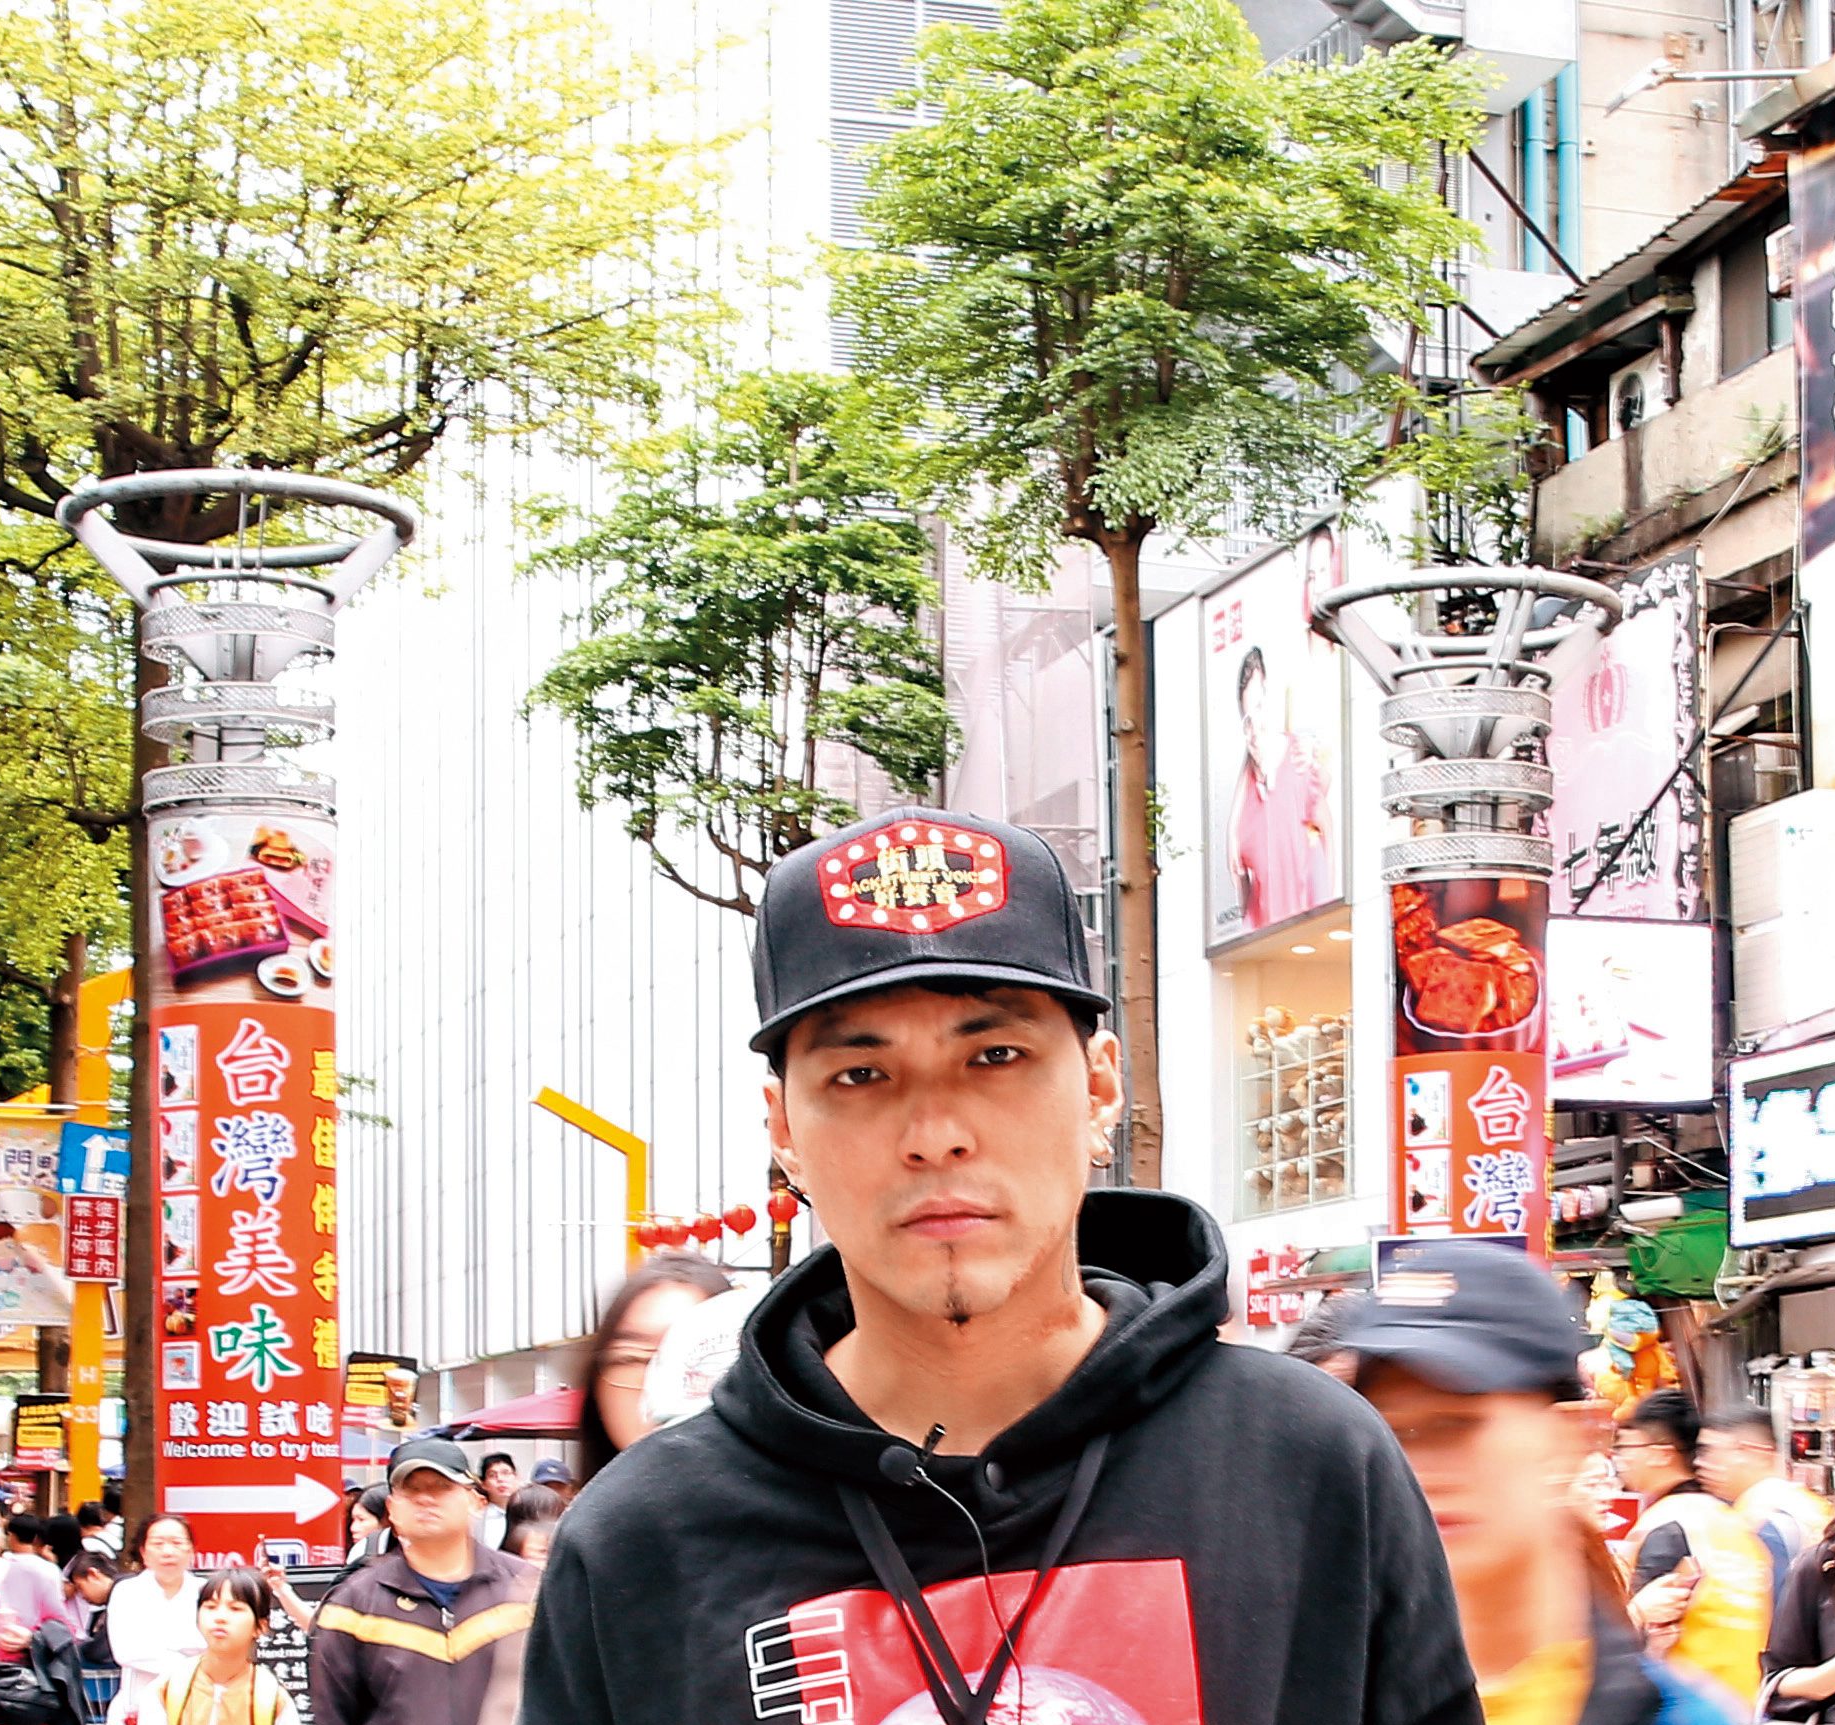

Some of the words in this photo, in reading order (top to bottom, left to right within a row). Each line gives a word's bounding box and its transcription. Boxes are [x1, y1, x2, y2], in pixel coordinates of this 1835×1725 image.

[1466, 1064, 1535, 1234] 台灣
[208, 1018, 304, 1393] 台灣美味
[162, 1440, 247, 1459] Welcome
[250, 1441, 277, 1458] to
[280, 1441, 310, 1461] try
[168, 1399, 334, 1438] 歡迎試吃
